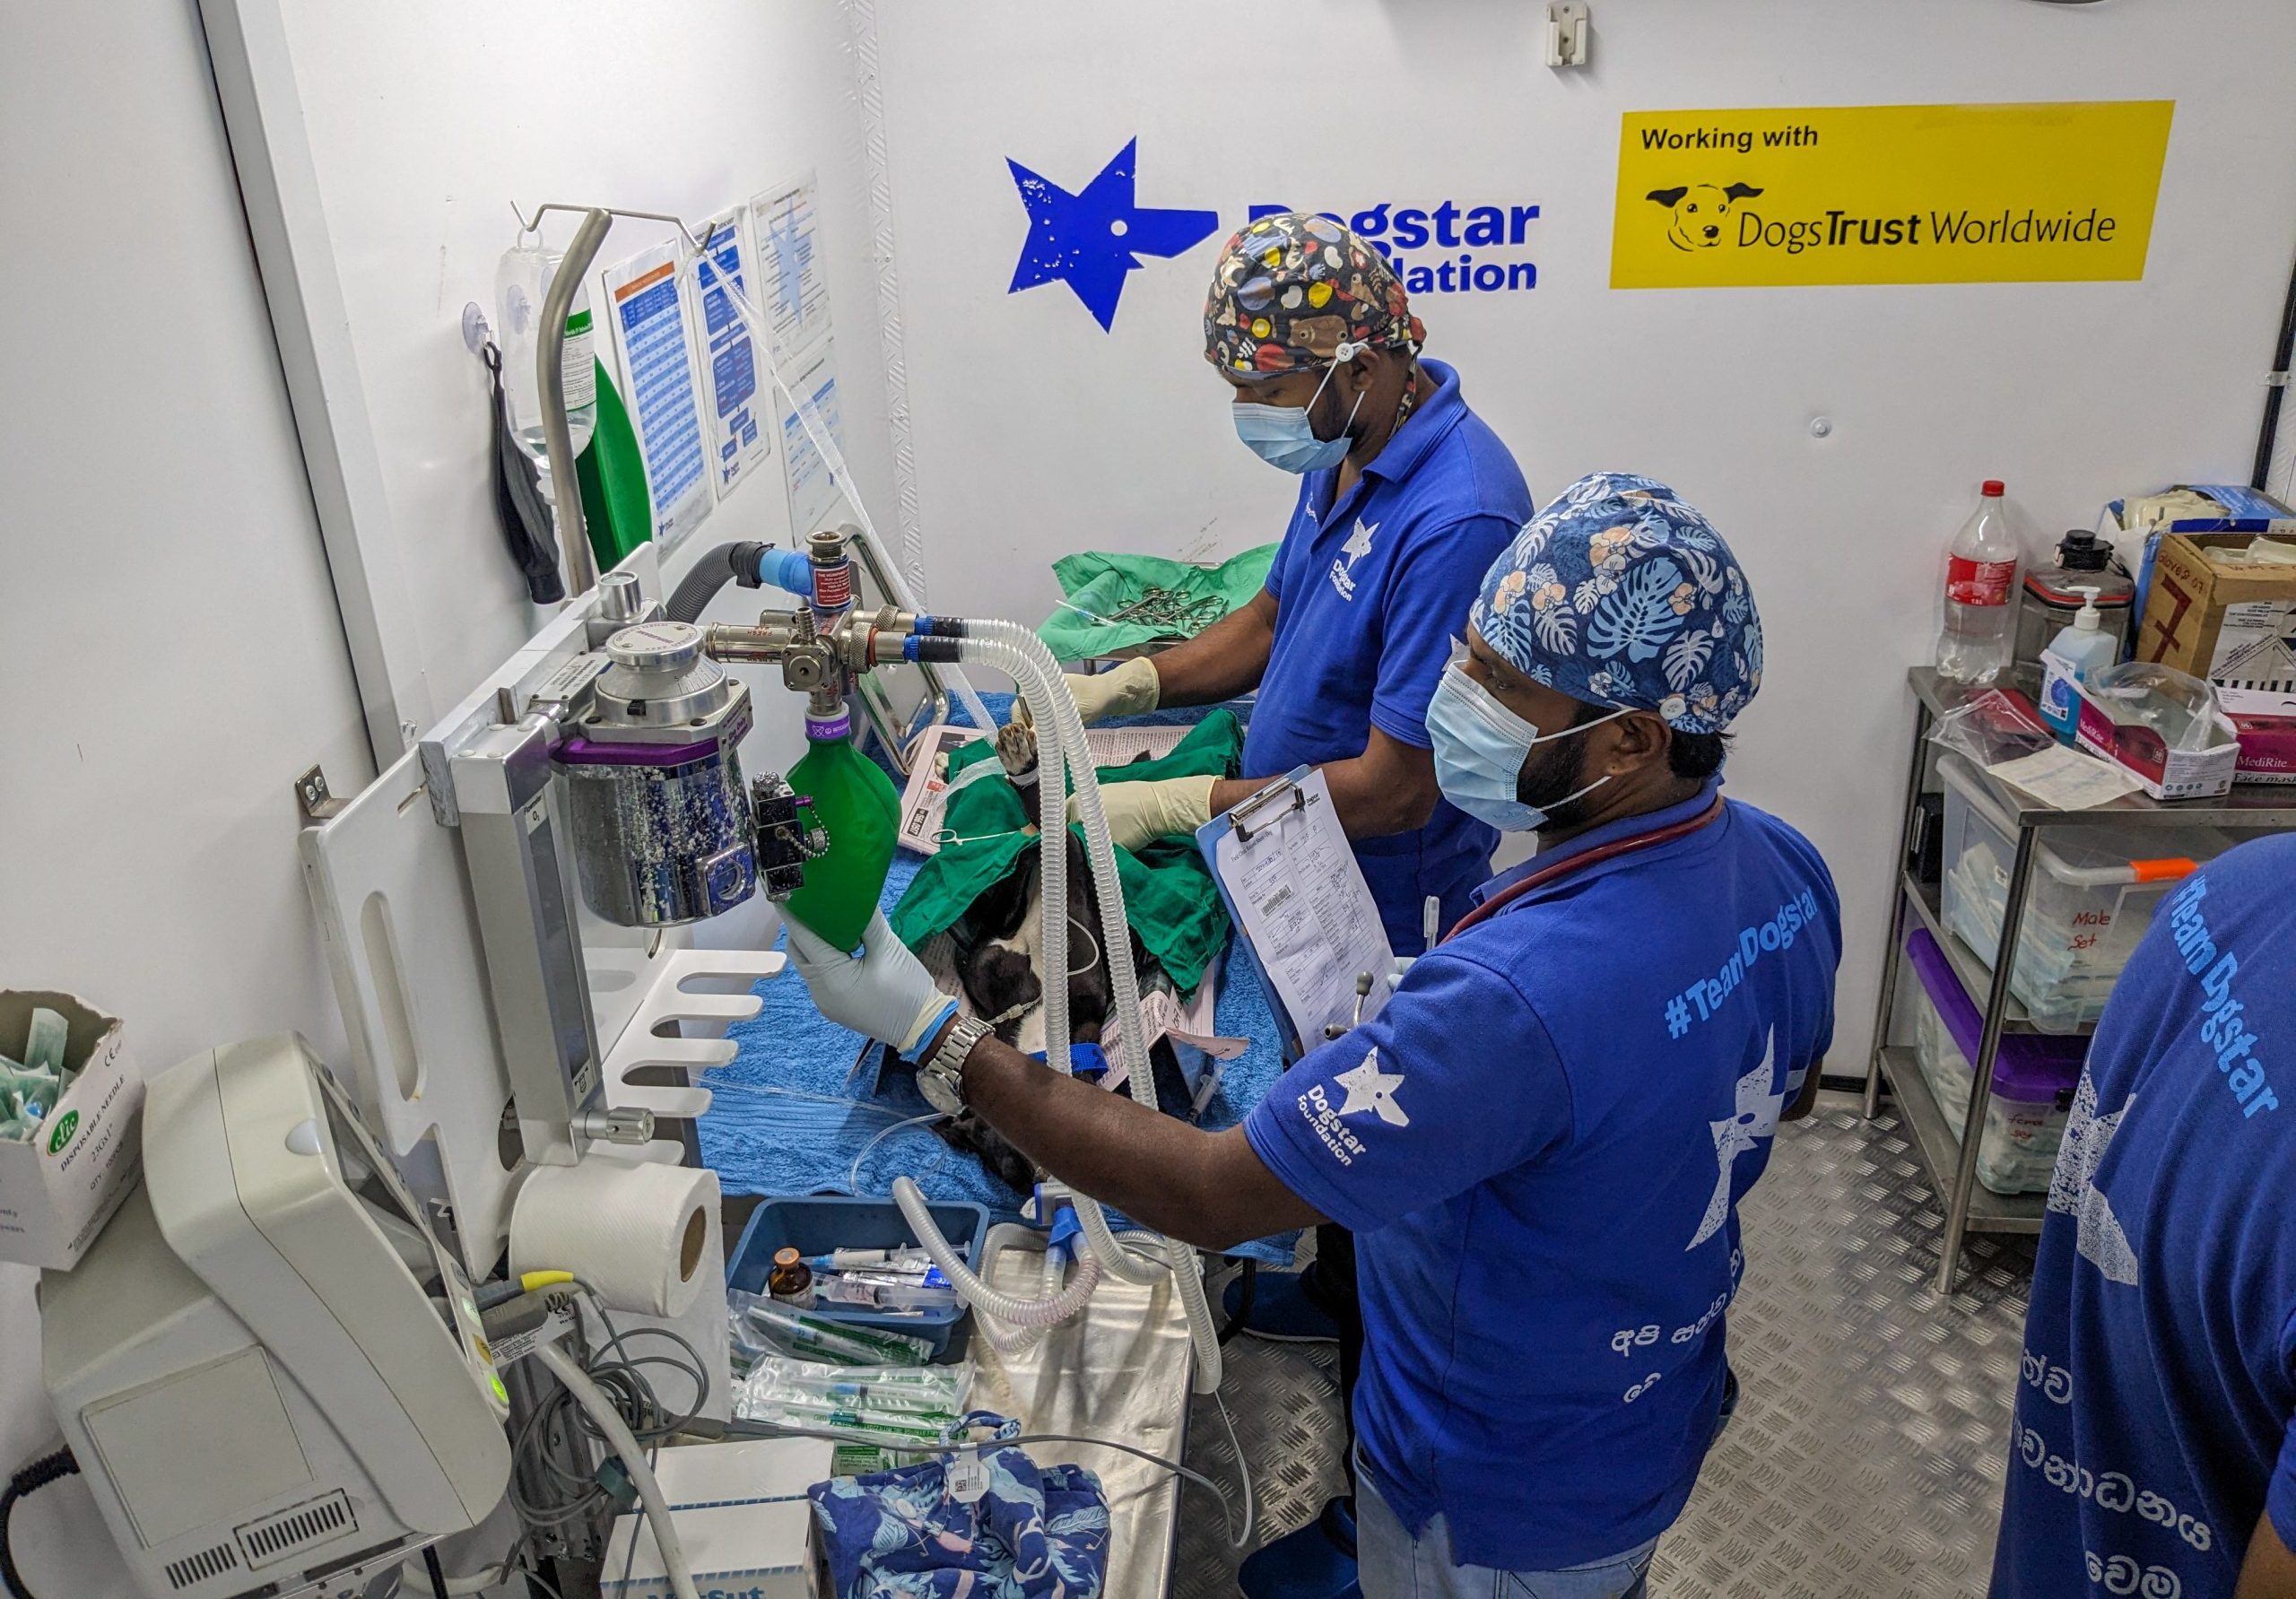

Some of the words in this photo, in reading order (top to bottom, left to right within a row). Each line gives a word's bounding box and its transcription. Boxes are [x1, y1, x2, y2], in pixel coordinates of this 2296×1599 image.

[1640, 126, 1753, 153] Working
[1761, 126, 1819, 148] with
[1248, 201, 1540, 250] gstar
[1737, 210, 1920, 255] DogsTrust
[1930, 207, 2116, 244] Worldwide
[1394, 254, 1537, 294] ation
[2238, 756, 2287, 769] MediRite
[2072, 908, 2110, 926] Male
[2067, 933, 2097, 951] Set
[54, 1114, 76, 1151] clic
[60, 1111, 101, 1172] DISPOSABLE
[101, 1074, 126, 1112] NEEDLE
[1298, 1094, 1352, 1166] Foundation
[1307, 1083, 1366, 1155] Dogstar
